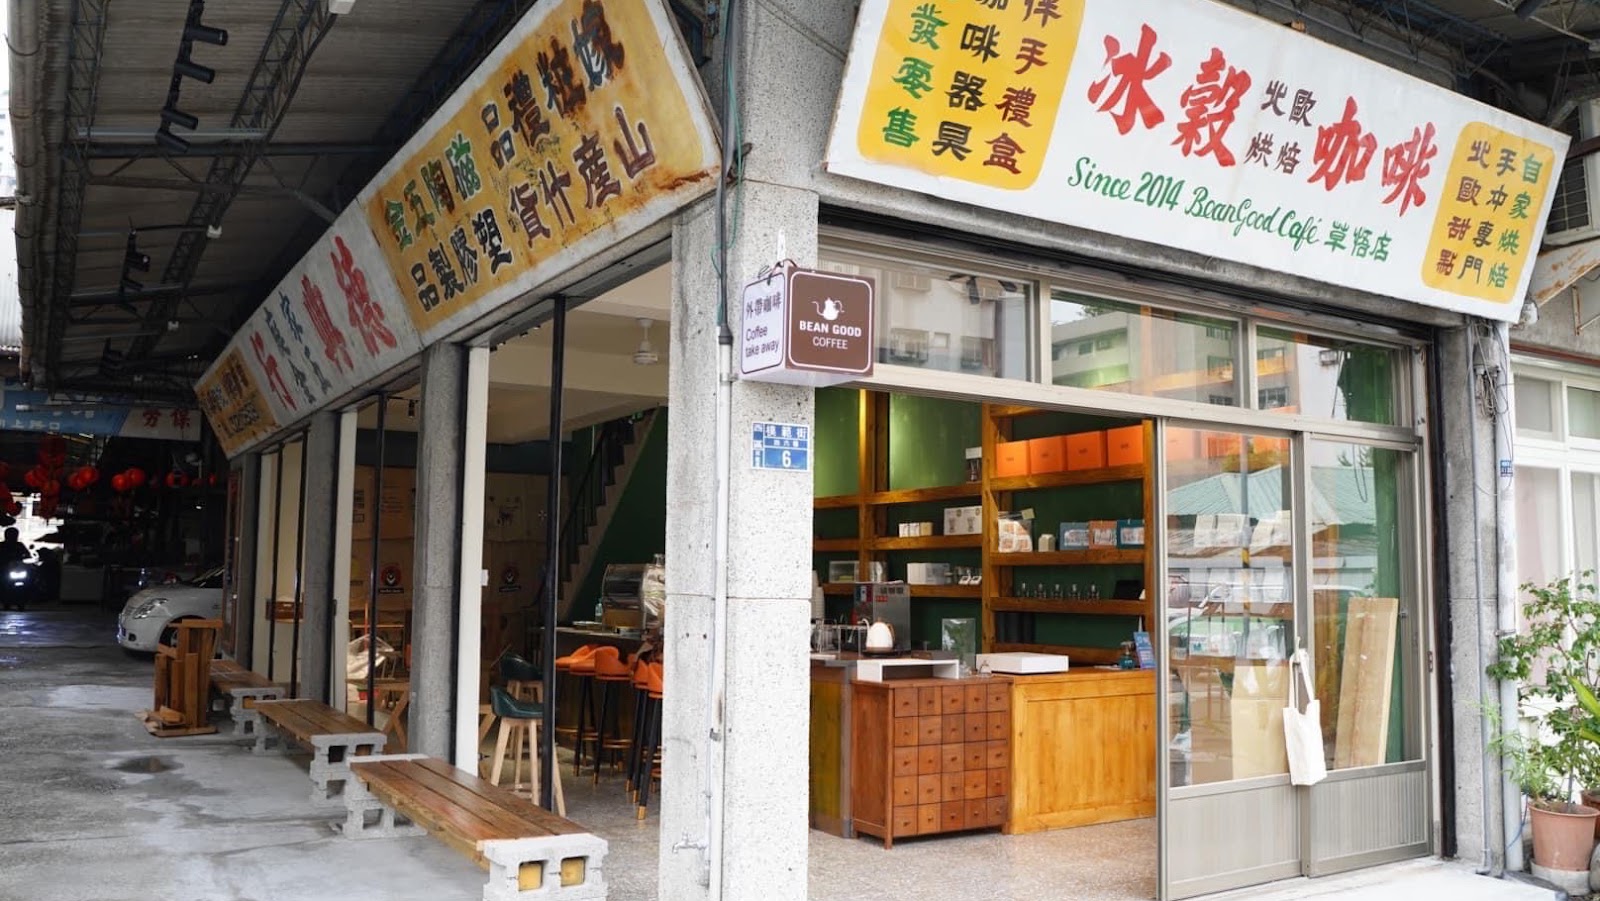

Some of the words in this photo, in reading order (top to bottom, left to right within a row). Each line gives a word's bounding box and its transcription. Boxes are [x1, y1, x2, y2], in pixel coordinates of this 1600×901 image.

[931, 0, 1008, 161] 啡器具
[1087, 22, 1252, 168] 冰穀
[1260, 78, 1318, 128] 北歐
[1243, 130, 1302, 176] 烘焙
[1306, 95, 1439, 218] 咖啡
[1067, 156, 1132, 201] Since
[1134, 171, 1186, 211] 2014
[1436, 140, 1491, 277] 北歐甜點
[1487, 154, 1543, 289] 自家烘焙
[745, 325, 769, 342] Coffee
[745, 345, 760, 358] take
[760, 340, 780, 355] away
[799, 320, 830, 334] BEAN
[832, 325, 862, 338] GOOD
[812, 336, 849, 350] COFFEE
[782, 450, 792, 468] 6
